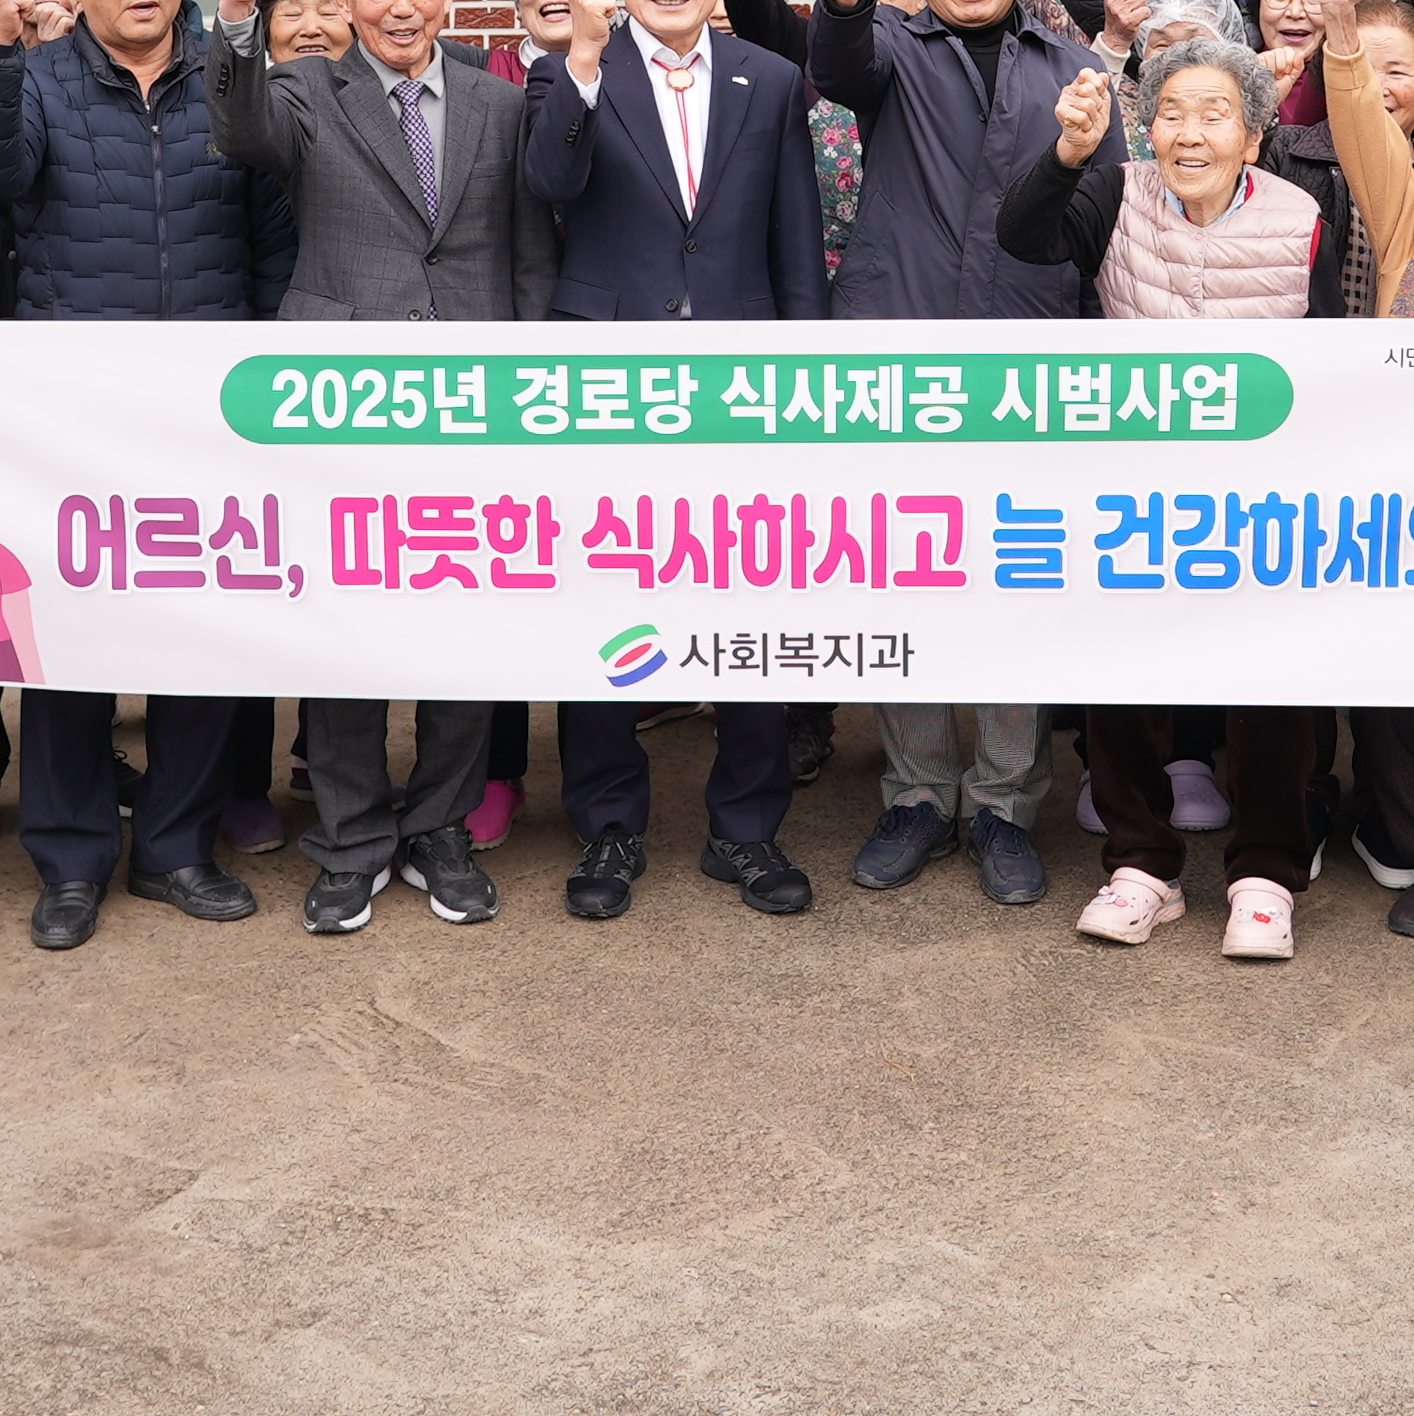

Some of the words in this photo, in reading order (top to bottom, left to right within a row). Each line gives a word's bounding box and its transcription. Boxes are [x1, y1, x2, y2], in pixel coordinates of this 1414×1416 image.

[272, 365, 488, 434] 2025년
[512, 365, 699, 434] 경로당
[720, 364, 969, 434] 식사제공
[992, 363, 1239, 433] 시범사업
[57, 494, 304, 598] 어르신,
[330, 494, 561, 589] 따뜻한
[582, 493, 967, 589] 식사하시고
[993, 493, 1067, 589] 늘
[679, 632, 915, 678] 사회복지과
